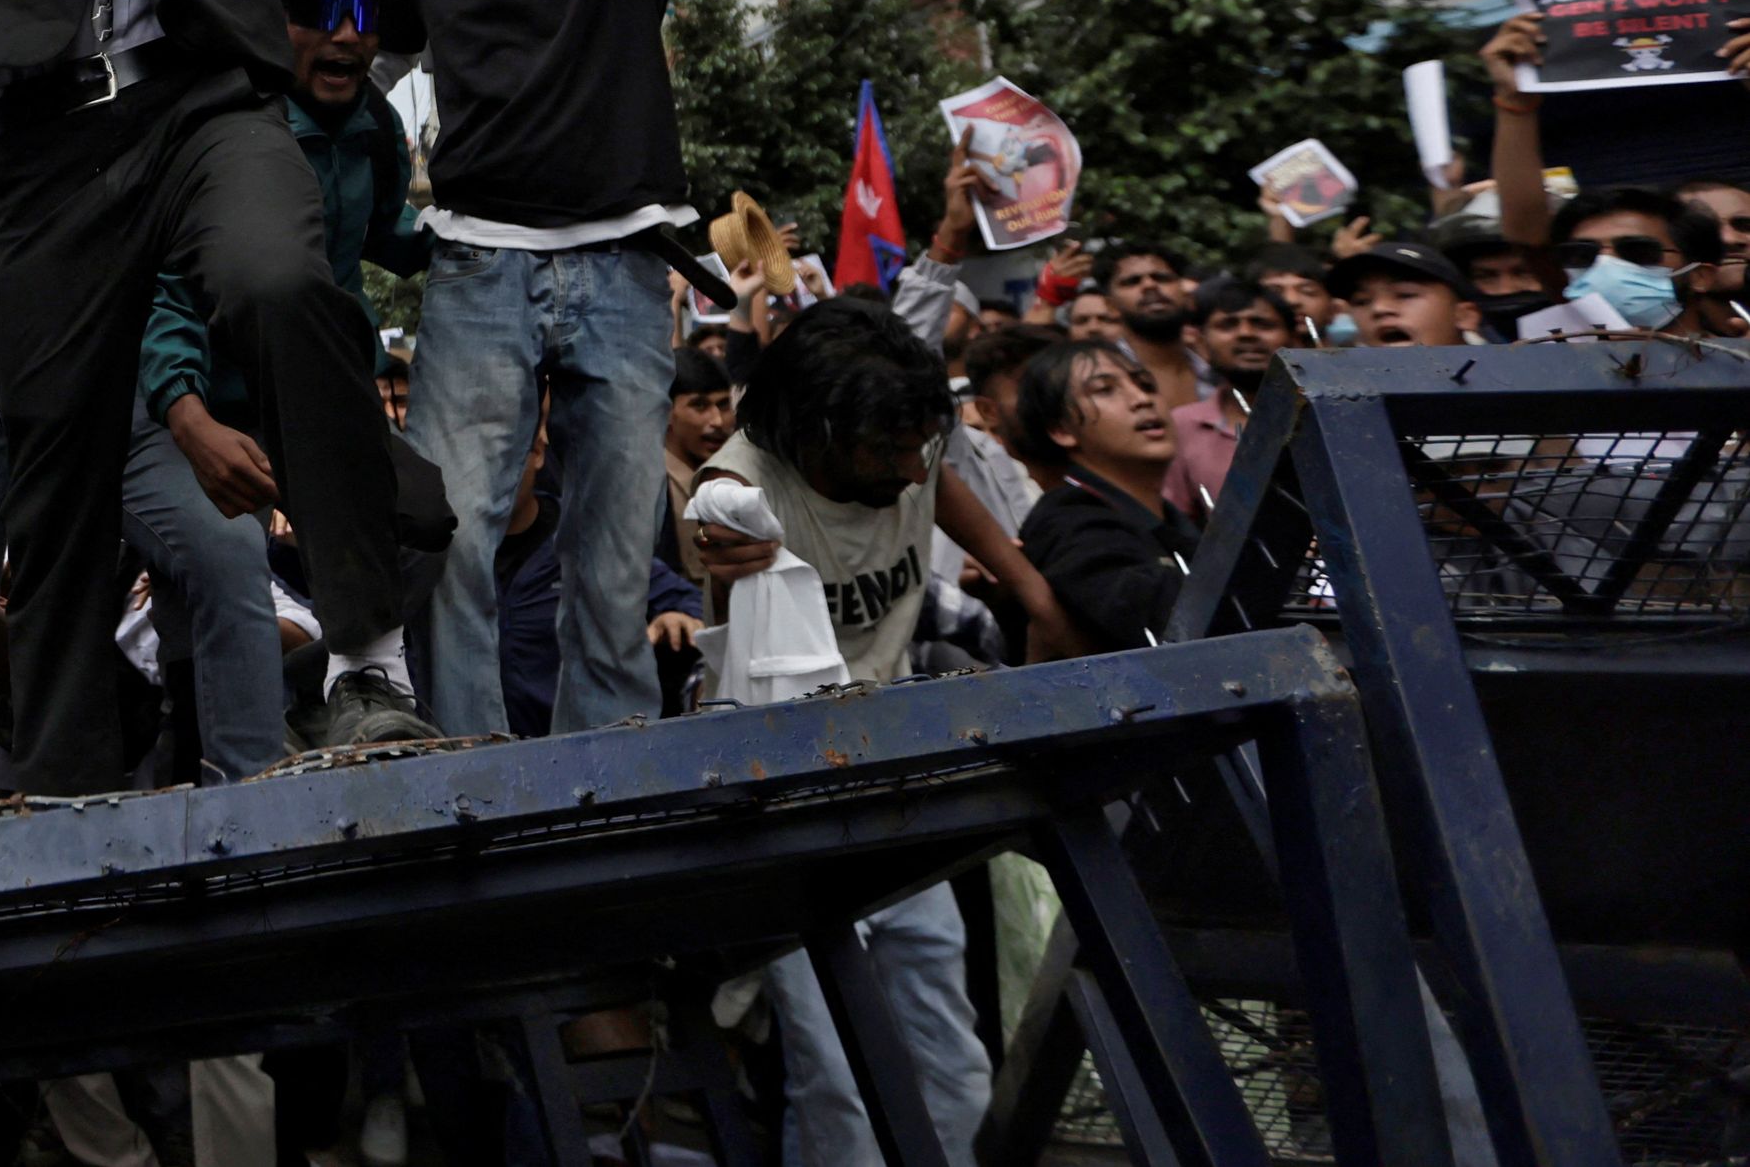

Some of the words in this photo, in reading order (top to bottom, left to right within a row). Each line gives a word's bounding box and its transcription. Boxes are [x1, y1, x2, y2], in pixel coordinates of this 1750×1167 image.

[1549, 0, 1606, 18] GEN
[1573, 21, 1610, 38] BE
[1615, 13, 1711, 34] SILENT
